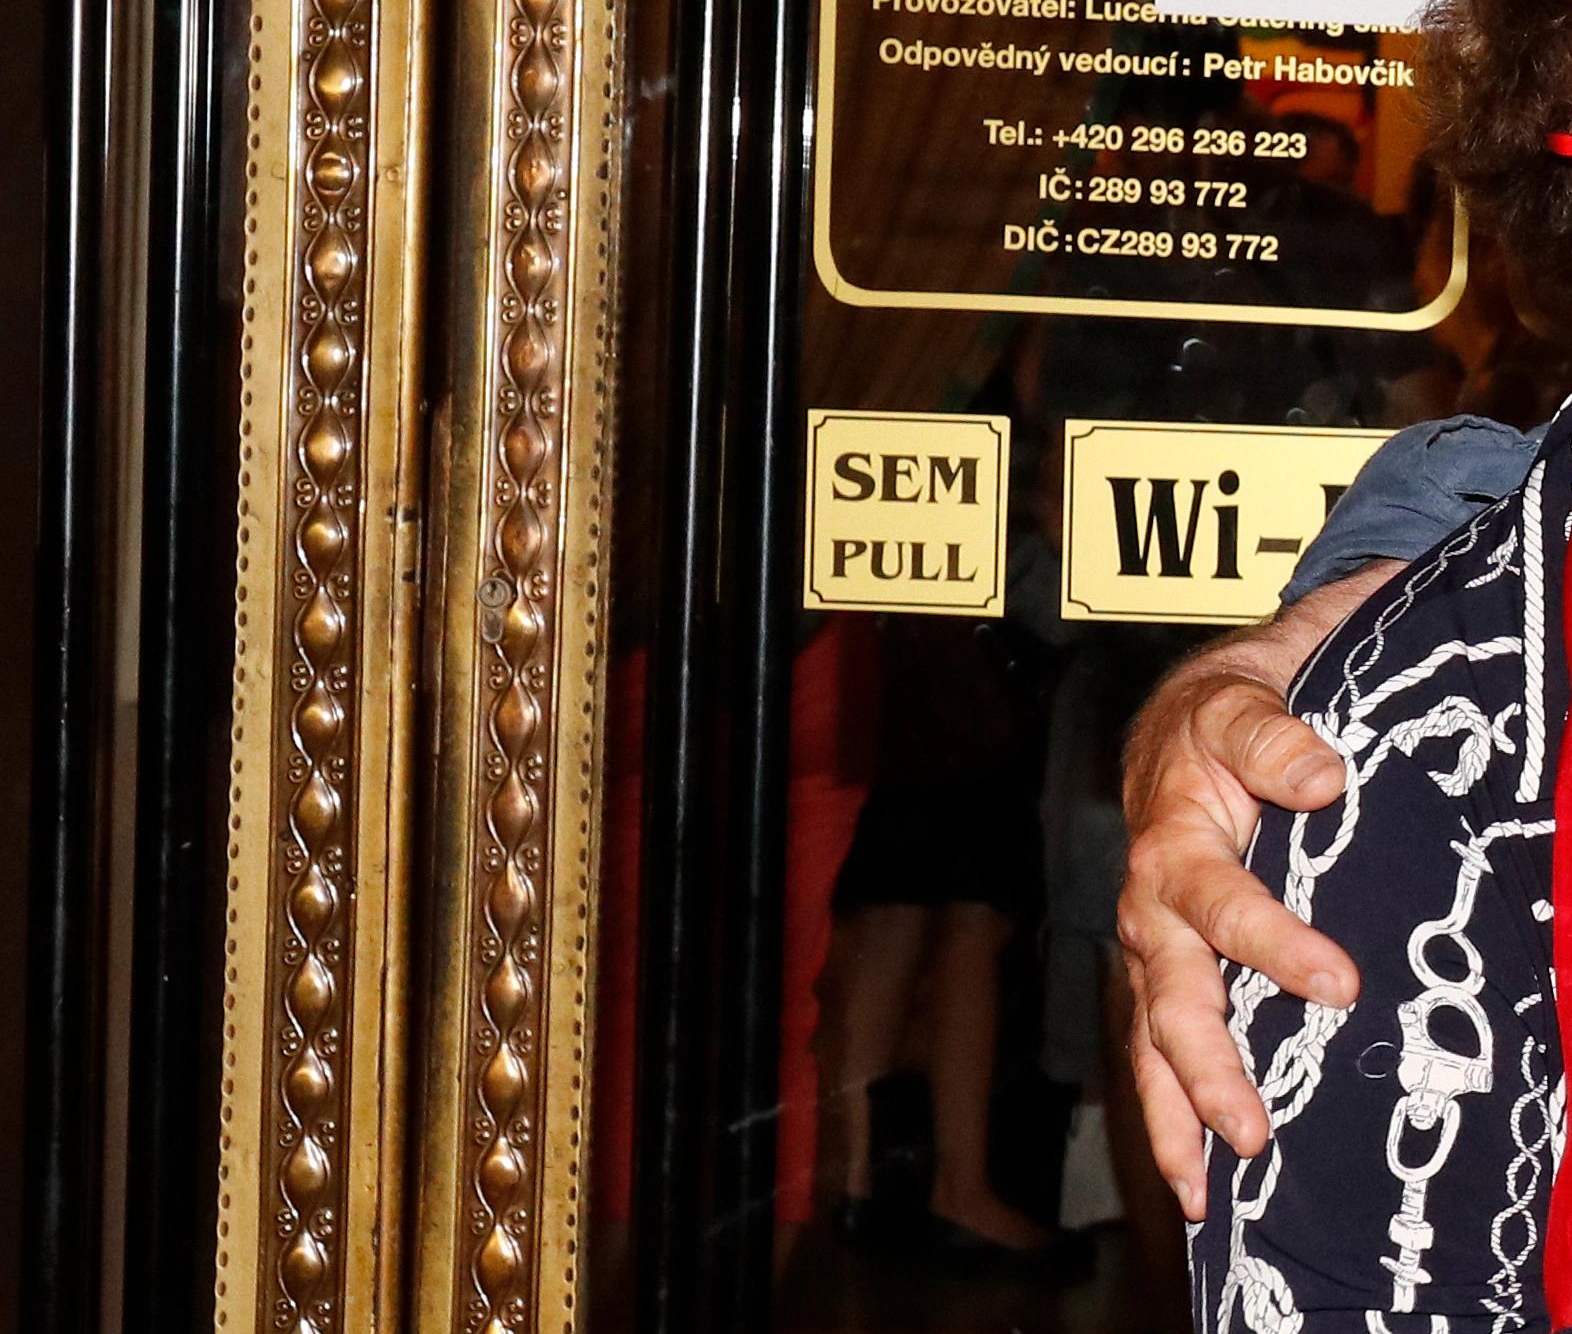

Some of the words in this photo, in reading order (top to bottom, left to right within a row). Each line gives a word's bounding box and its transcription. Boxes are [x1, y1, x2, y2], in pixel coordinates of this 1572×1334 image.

[878, 38, 1049, 76] Odpovědný
[1203, 53, 1266, 80] Petr
[1274, 55, 1414, 87] Habovčík
[983, 119, 1043, 148] Tel.:
[1052, 126, 1123, 151] +420
[1131, 129, 1184, 154] 296
[1193, 132, 1245, 157] 236
[1254, 134, 1307, 160] 223
[1149, 180, 1185, 206] 93
[1194, 183, 1247, 208] 772
[1181, 232, 1217, 259] 93
[1226, 234, 1279, 261] 772
[831, 451, 981, 506] SEM
[1105, 470, 1352, 579] Wi-
[830, 539, 979, 585] PULL
